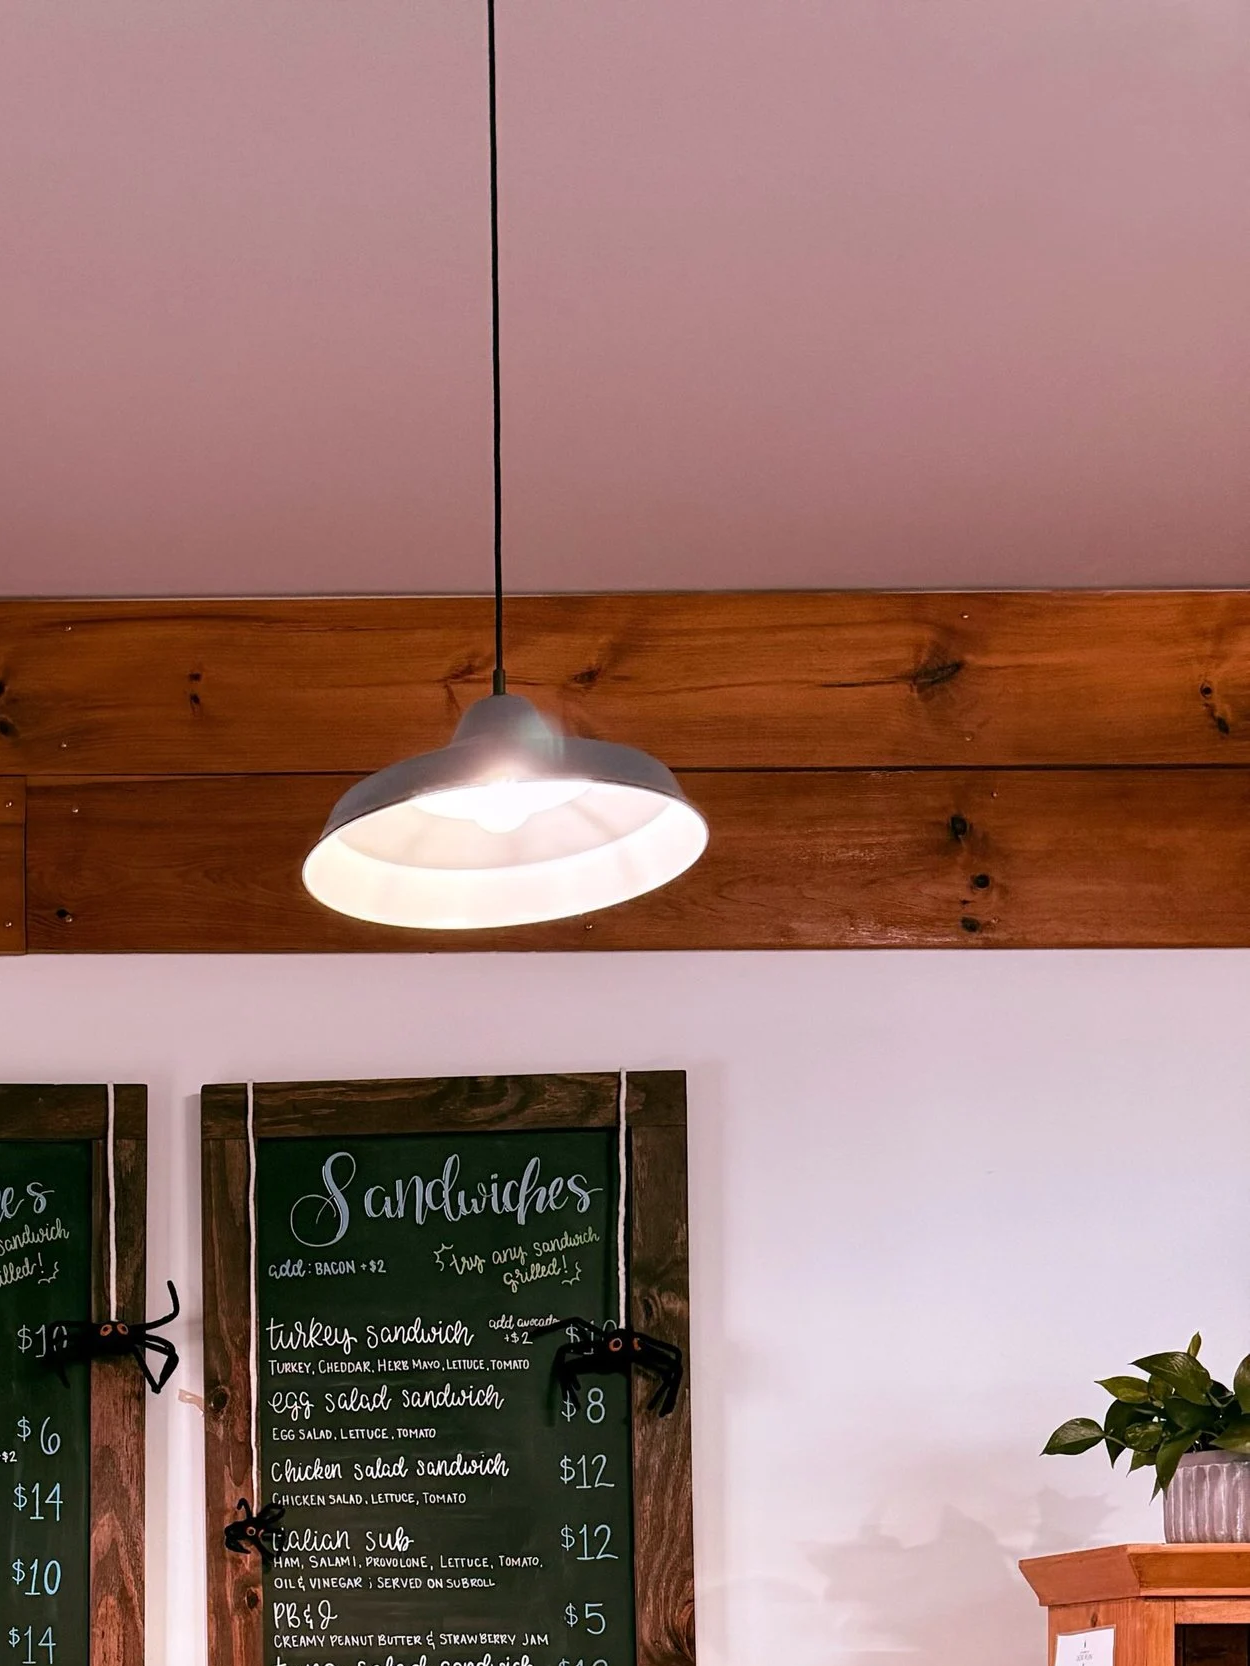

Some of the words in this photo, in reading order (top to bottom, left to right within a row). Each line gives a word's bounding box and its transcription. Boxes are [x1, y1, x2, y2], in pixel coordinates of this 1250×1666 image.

[290, 1151, 604, 1247] Sandwiches
[315, 1260, 355, 1275] BACON
[361, 1260, 386, 1272] +$2
[450, 1254, 485, 1274] try
[493, 1246, 527, 1265] any
[533, 1227, 599, 1256] sandwich
[503, 1255, 569, 1293] grilled!
[266, 1317, 357, 1354] turkey
[367, 1317, 474, 1348] sandwich
[489, 1315, 514, 1329] add
[504, 1332, 533, 1344] +$2
[268, 1392, 314, 1421] egg
[325, 1385, 392, 1412] salad
[402, 1383, 504, 1409] sandwich
[354, 1457, 408, 1480] salad
[417, 1453, 509, 1476] sandwich
[560, 1455, 614, 1488] $12
[13, 1483, 63, 1521] $14
[273, 1529, 350, 1551] ialian
[561, 1524, 618, 1560] $12
[12, 1559, 60, 1595] $10
[9, 1626, 56, 1664] $14
[274, 1635, 325, 1648] CREAMY
[330, 1635, 373, 1646] PEANUT
[378, 1634, 422, 1645] BUTTER
[440, 1633, 515, 1645] STRAWBERRY
[523, 1634, 548, 1645] JAM
